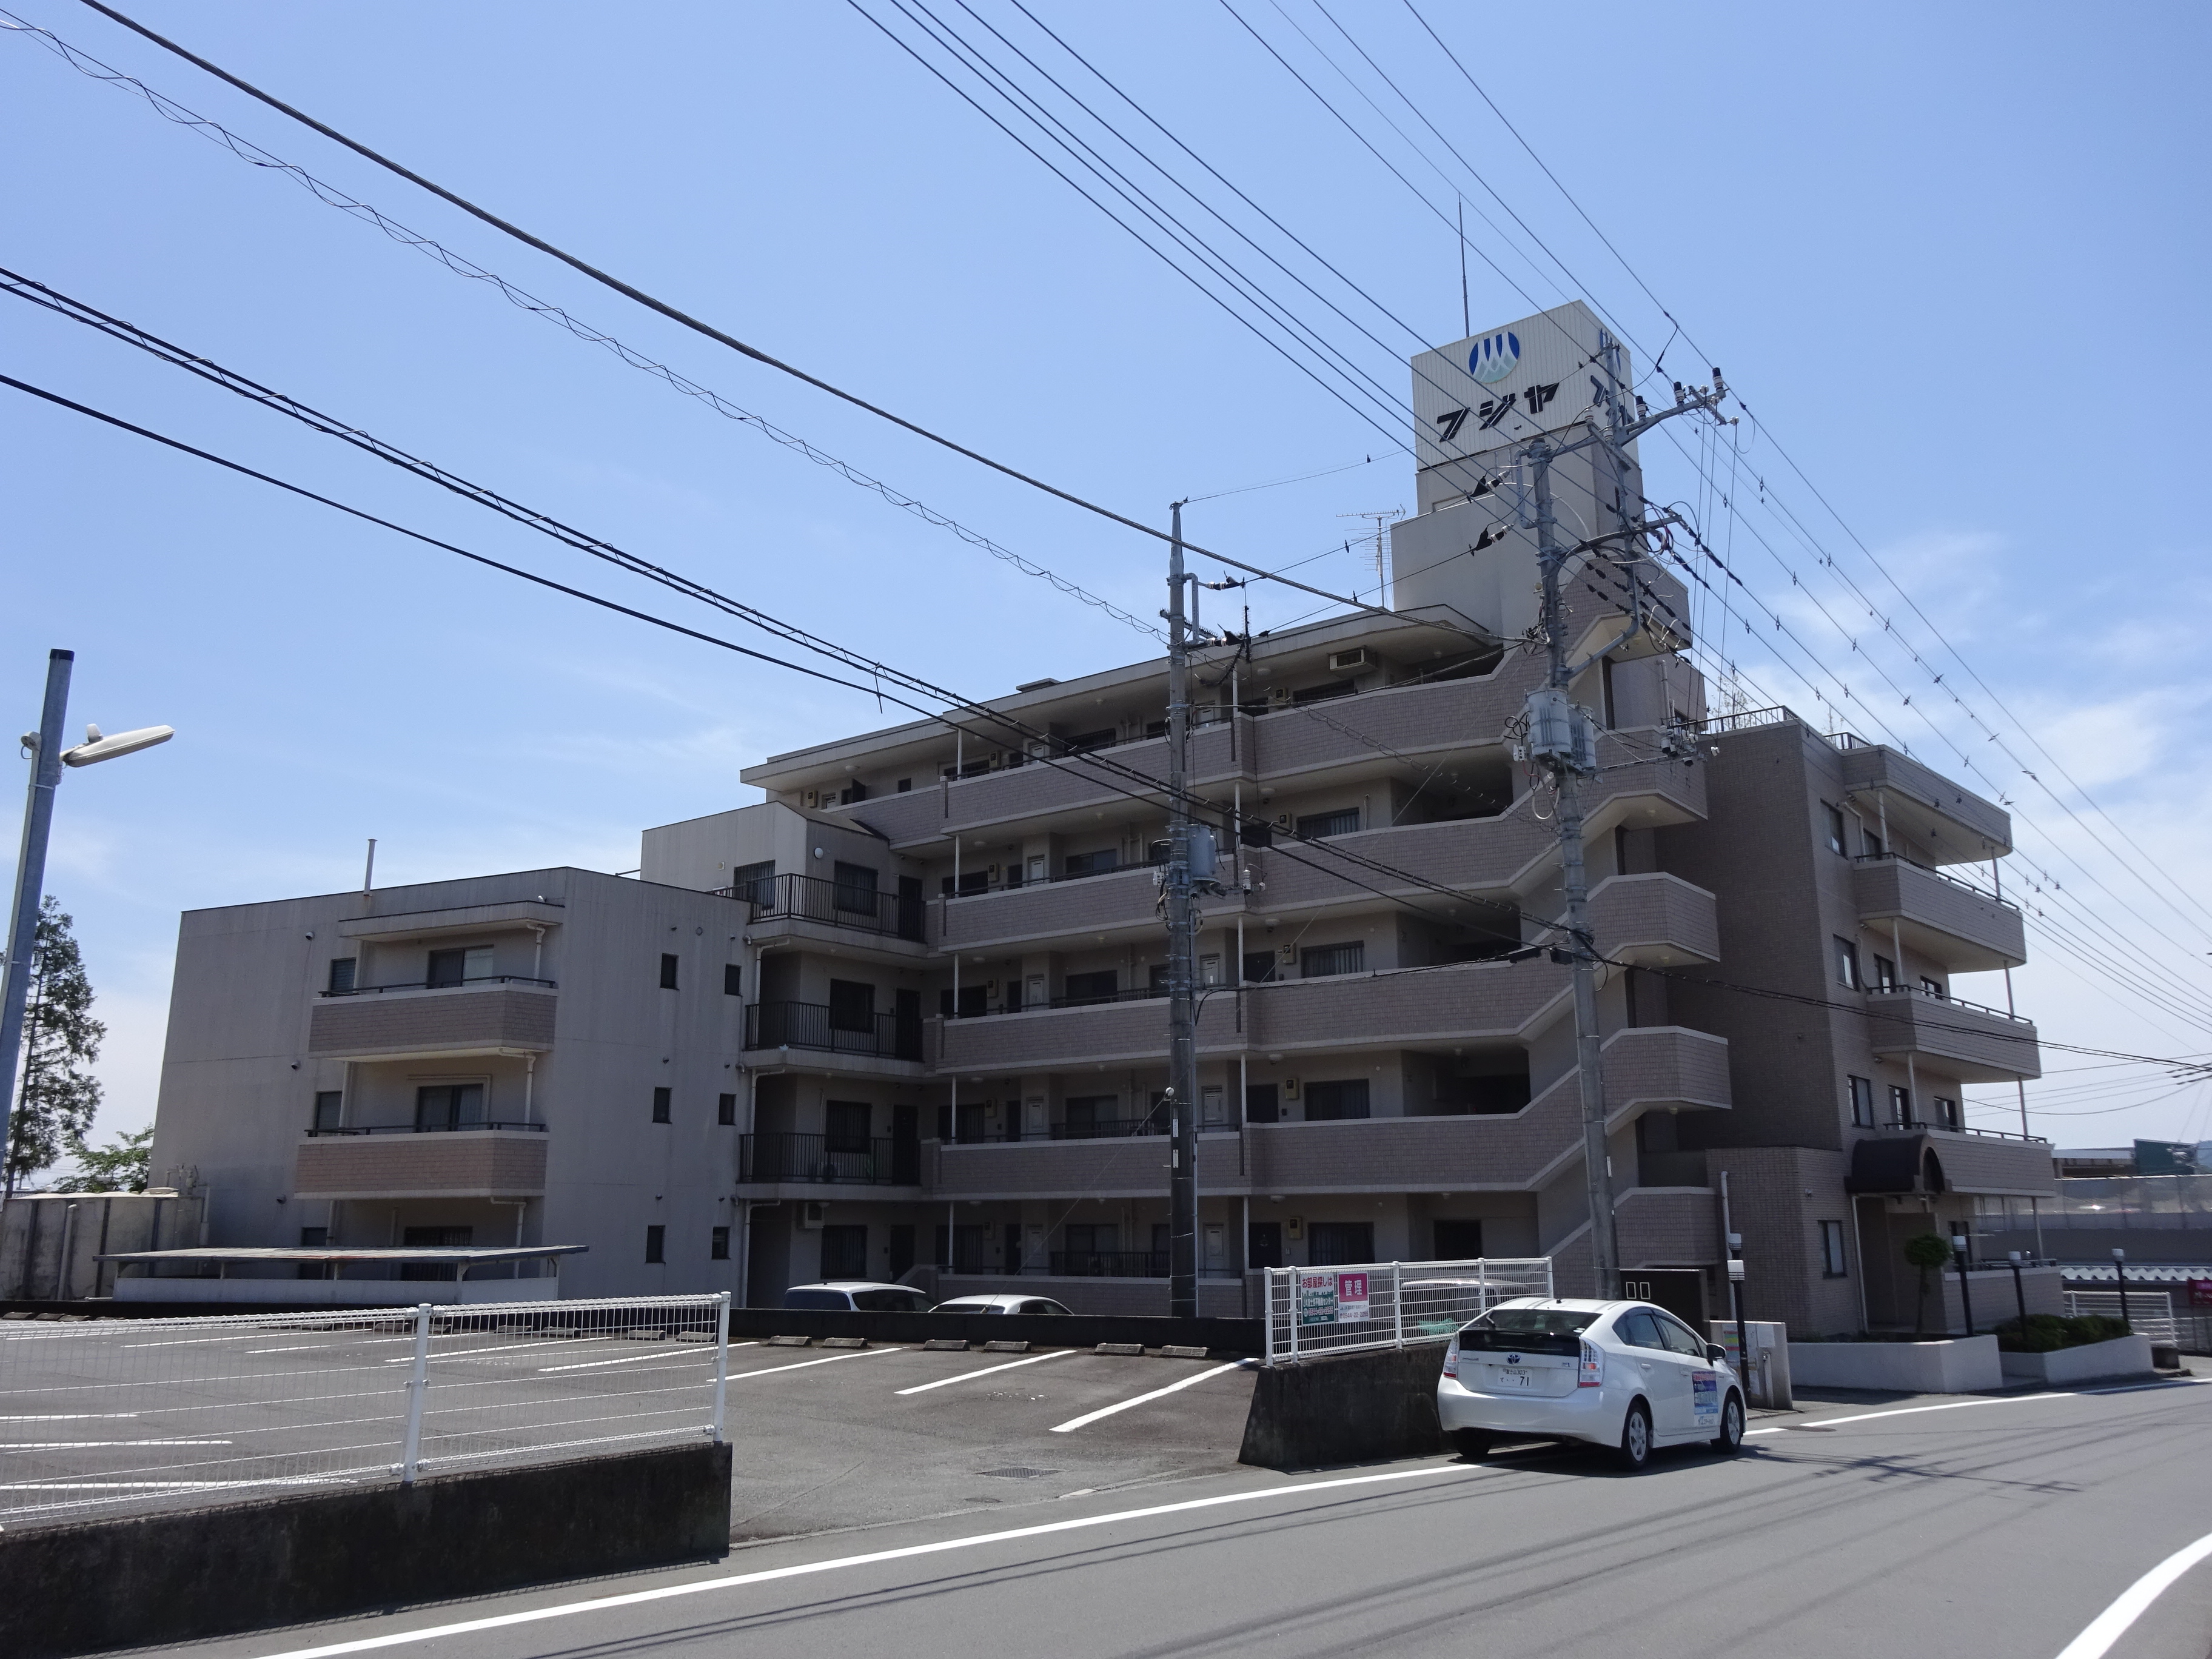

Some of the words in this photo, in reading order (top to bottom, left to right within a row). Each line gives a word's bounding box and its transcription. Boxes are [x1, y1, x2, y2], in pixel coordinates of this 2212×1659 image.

[1436, 382, 1559, 442] フジヤ
[1302, 1276, 1333, 1289] お部屋探しは
[1344, 1279, 1362, 1296] 管理
